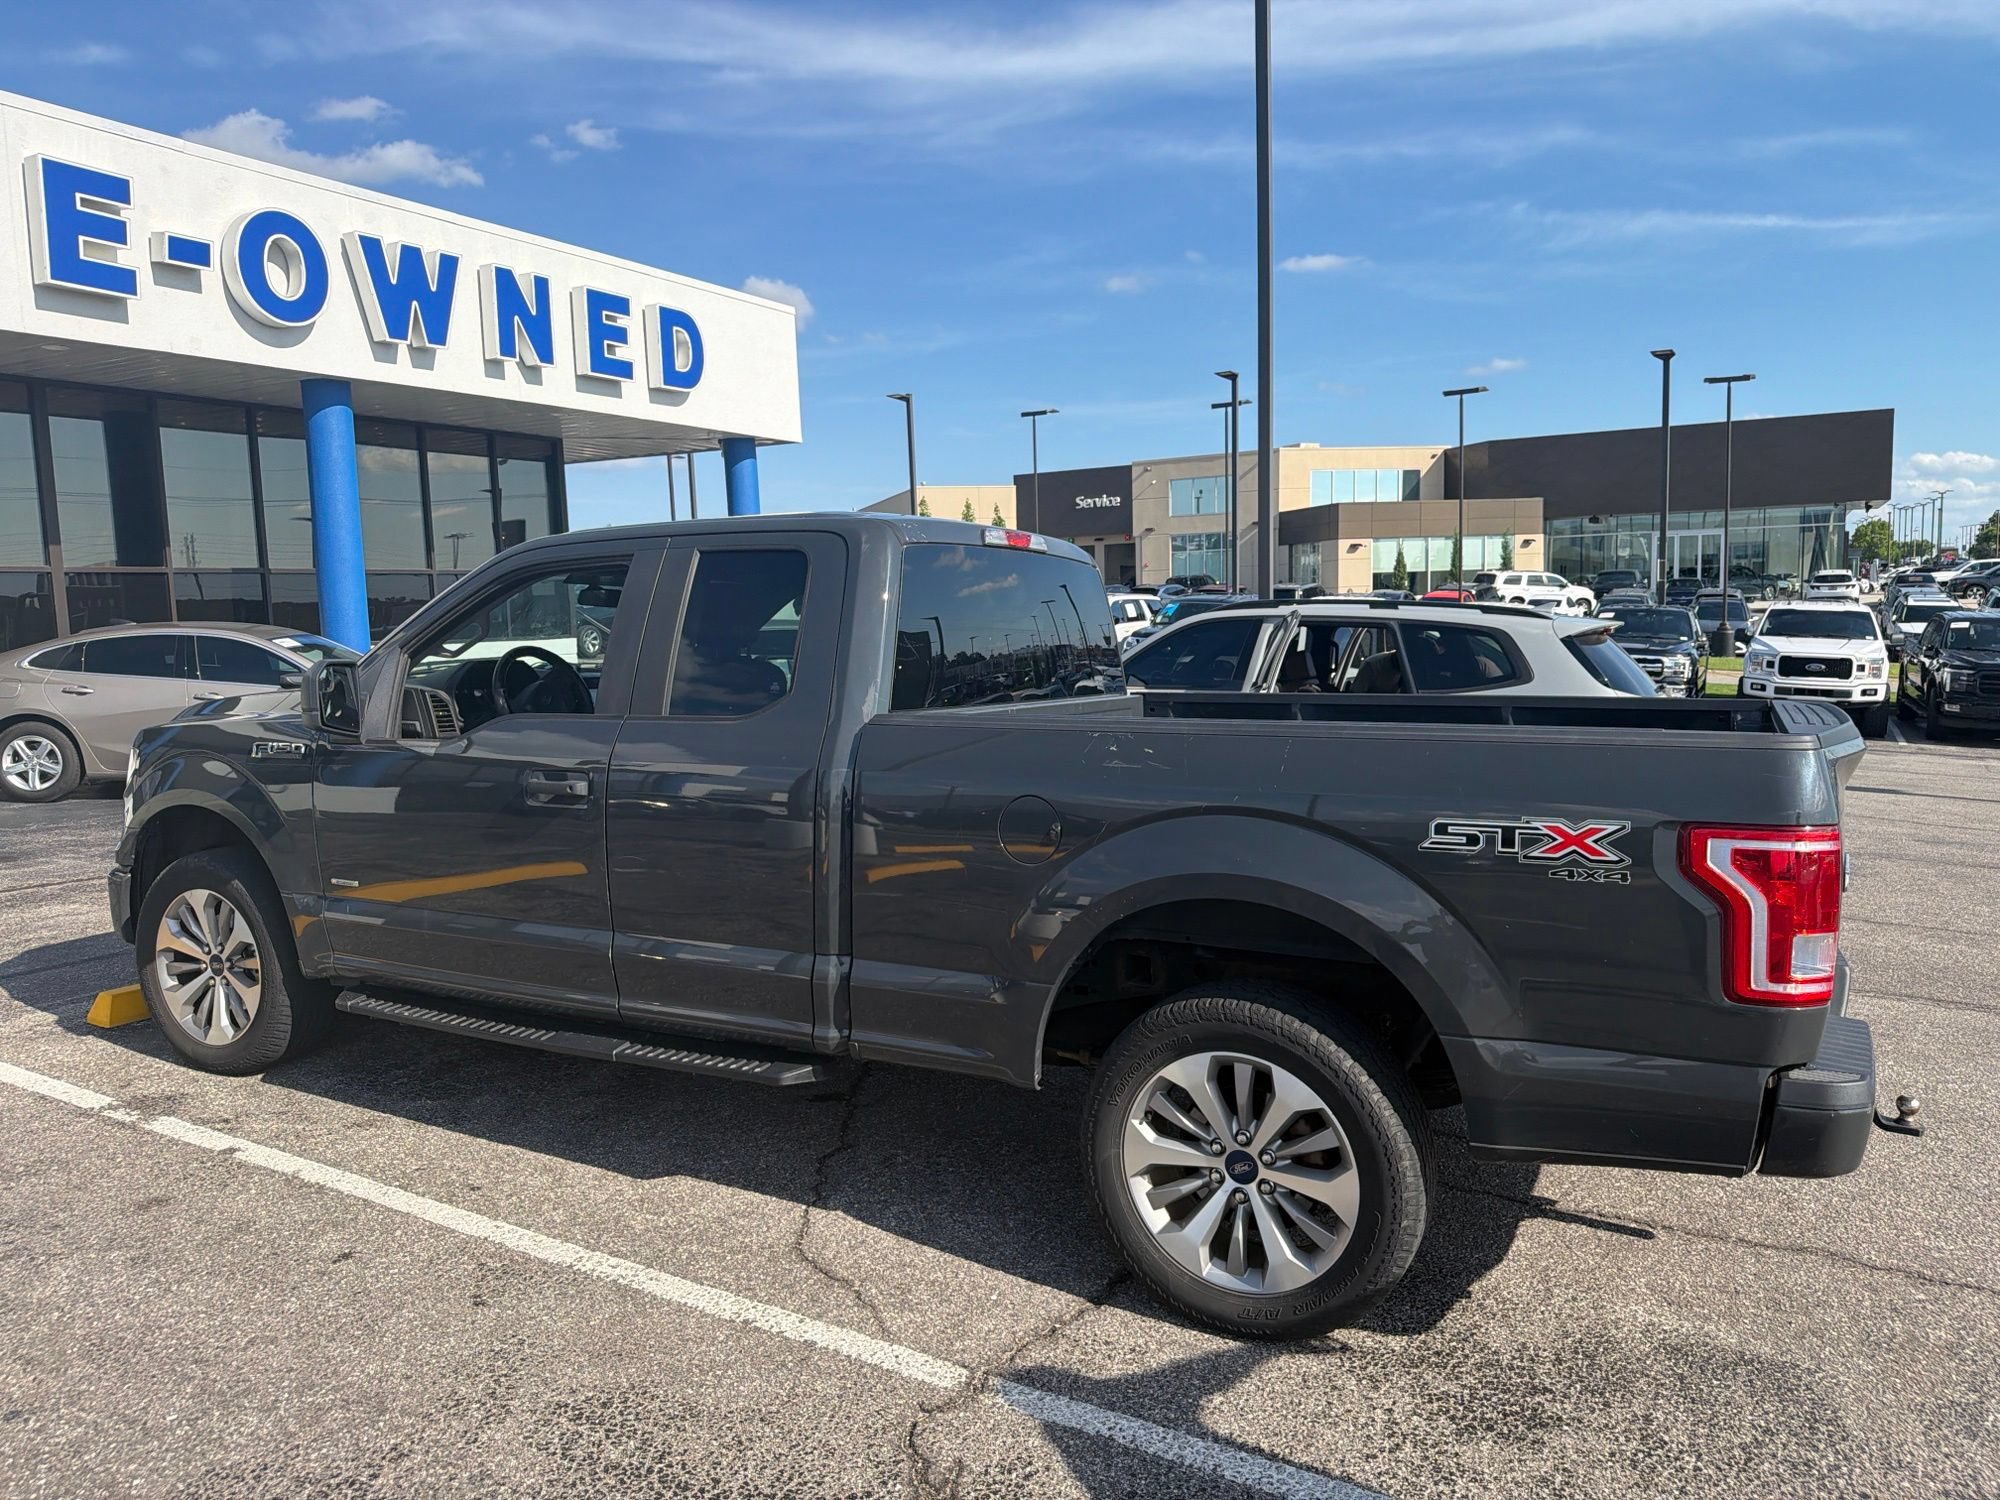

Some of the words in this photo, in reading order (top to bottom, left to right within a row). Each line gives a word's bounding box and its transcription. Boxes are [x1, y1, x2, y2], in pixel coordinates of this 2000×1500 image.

[25, 153, 705, 394] E-OWNED
[1075, 494, 1121, 509] Service
[1418, 816, 1632, 868] STX
[1107, 1033, 1193, 1107] YOKOHAMA
[1293, 1210, 1382, 1316] ANDAR
[1236, 1306, 1283, 1321] A/T
